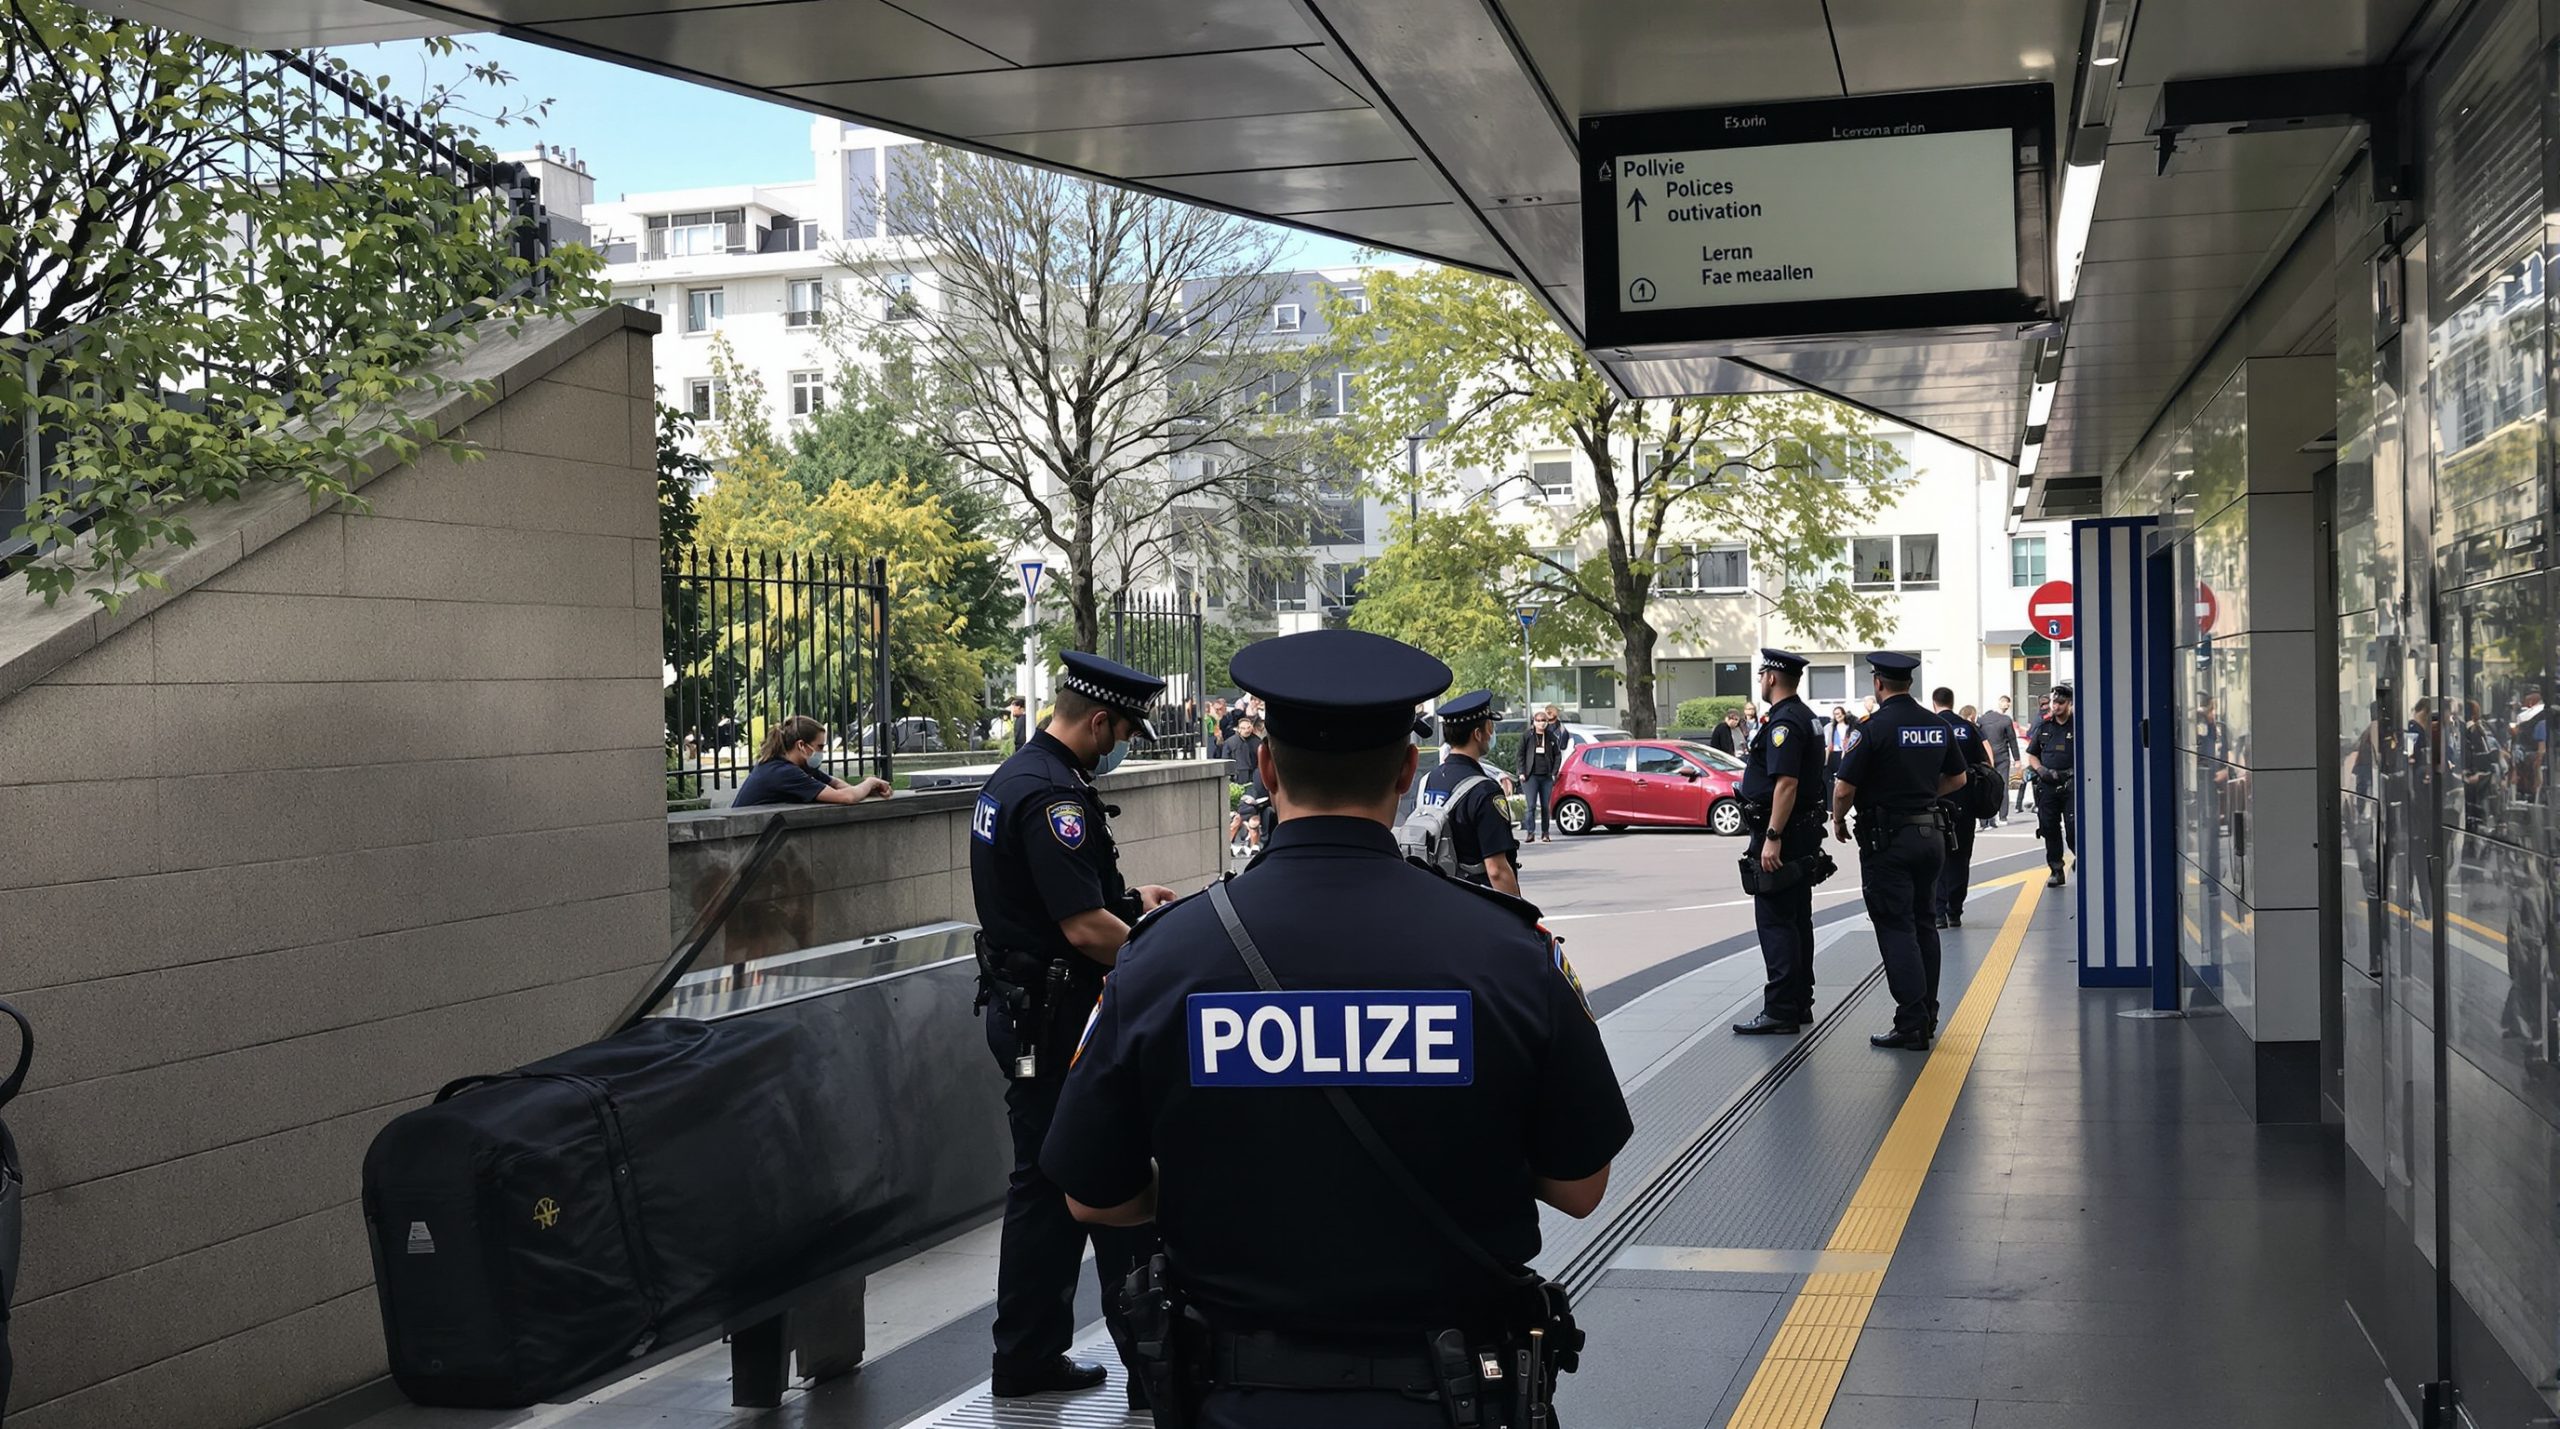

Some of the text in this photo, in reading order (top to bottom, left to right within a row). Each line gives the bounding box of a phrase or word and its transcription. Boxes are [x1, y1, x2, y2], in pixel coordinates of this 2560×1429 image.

[1623, 158, 1686, 178] Pollvie
[1666, 179, 1734, 198] Polices
[1667, 200, 1762, 222] outivation
[1701, 264, 1814, 285] Fae meaallen
[1902, 729, 1944, 745] POLICE
[1200, 1004, 1460, 1074] POLIZE
